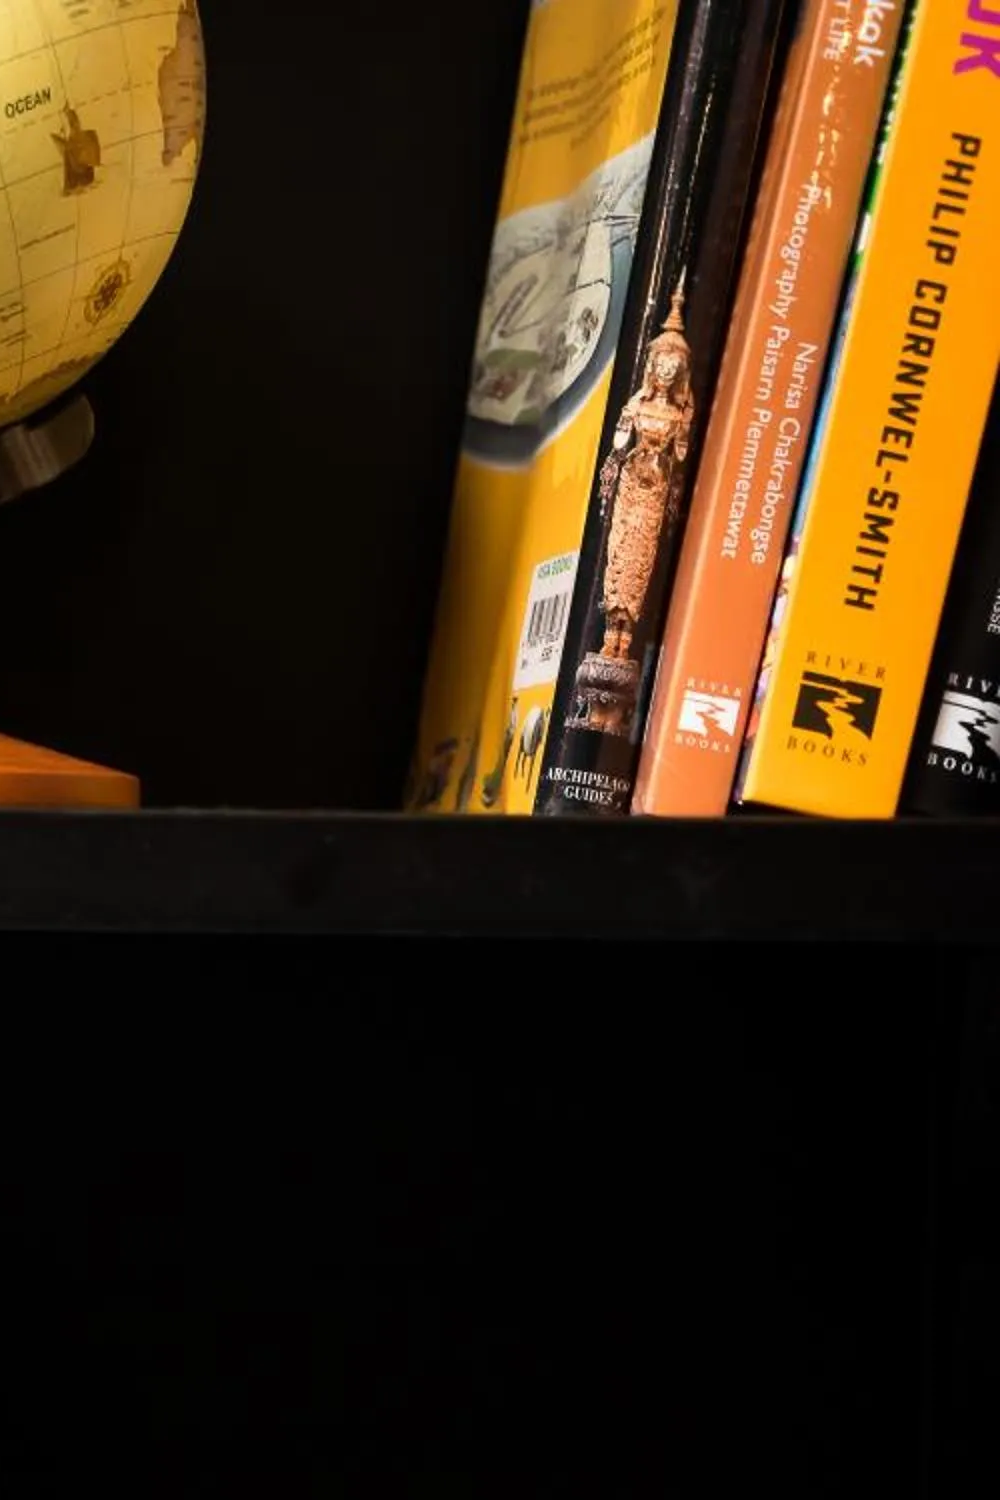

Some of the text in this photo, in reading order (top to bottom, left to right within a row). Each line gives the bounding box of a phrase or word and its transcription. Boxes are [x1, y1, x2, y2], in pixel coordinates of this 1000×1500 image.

[824, 18, 846, 61] LIFE
[4, 87, 52, 119] OCEAN
[769, 184, 822, 319] Photography
[755, 324, 790, 402] Paisarn
[843, 131, 982, 611] PHILIP CORNWEL-SMITH
[751, 341, 819, 565] Narisa Chakrabongse
[807, 651, 885, 679] RIVER
[787, 736, 867, 766] BOOKS
[546, 767, 631, 793] ARCHIPELAGO
[563, 784, 614, 804] GUIDES
